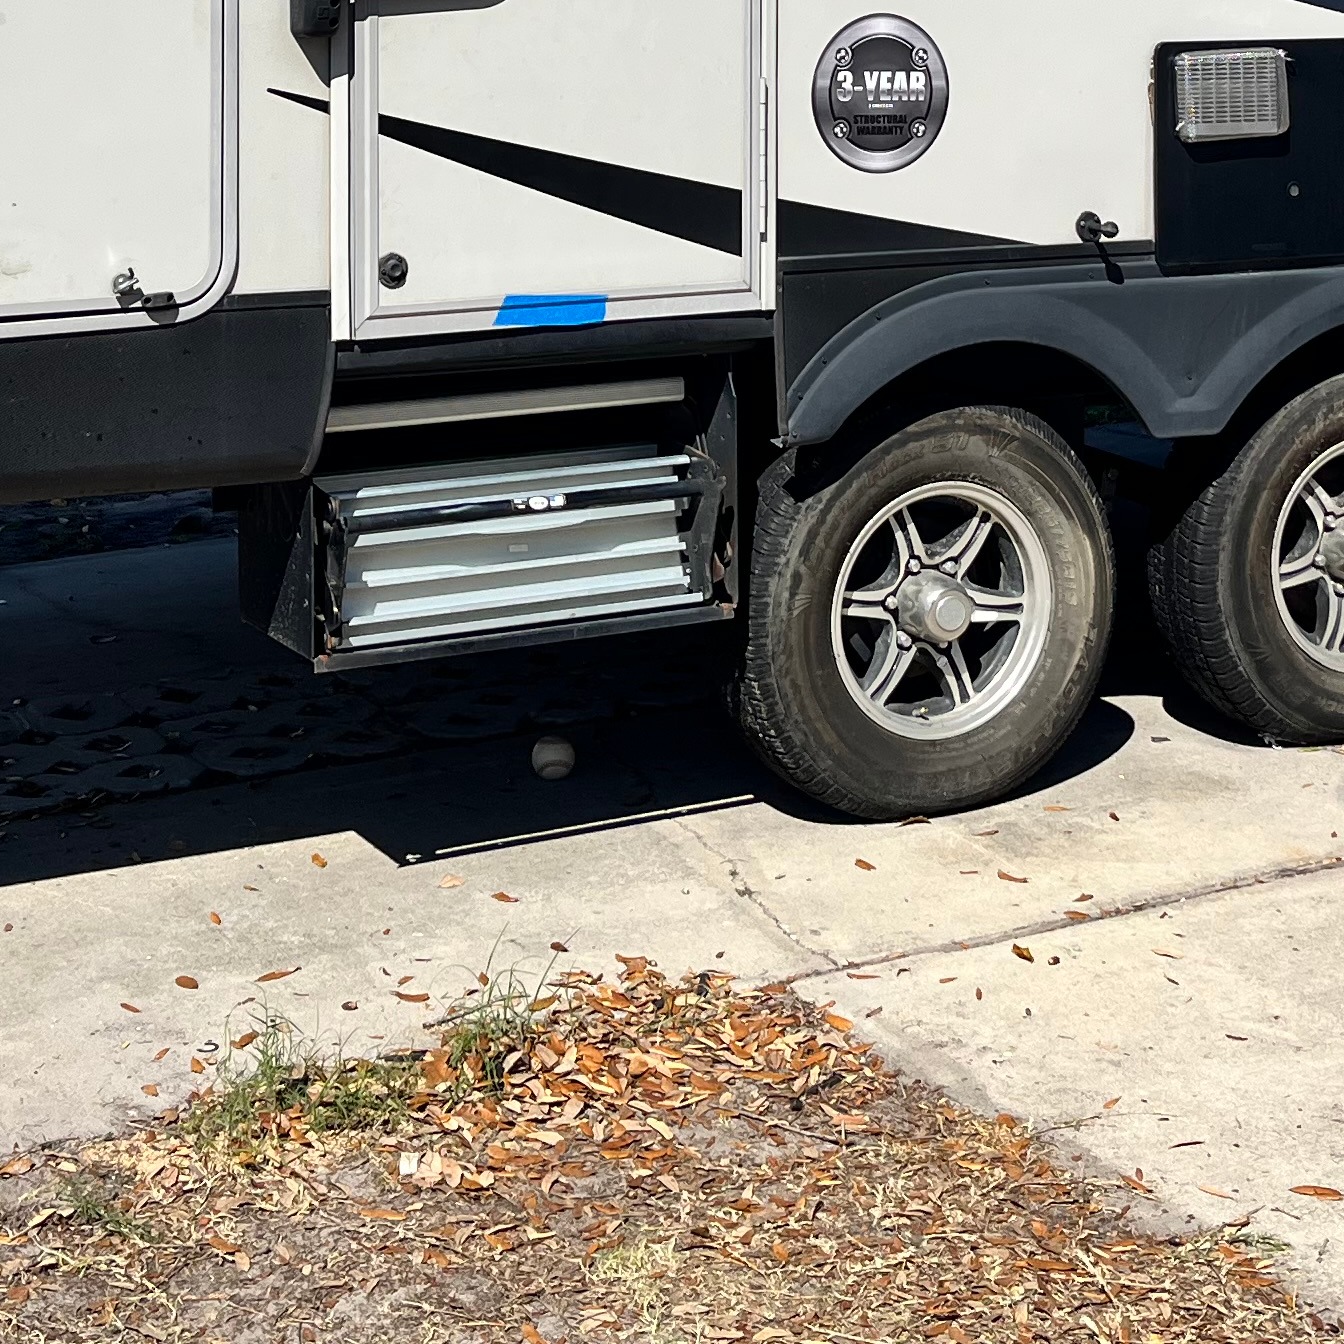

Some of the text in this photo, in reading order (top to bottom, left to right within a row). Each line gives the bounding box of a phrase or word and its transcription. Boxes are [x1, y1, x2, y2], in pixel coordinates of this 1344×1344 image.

[836, 70, 926, 102] 3-YEAR
[853, 114, 908, 124] STRUCTURAL
[856, 125, 904, 135] WARRANTY
